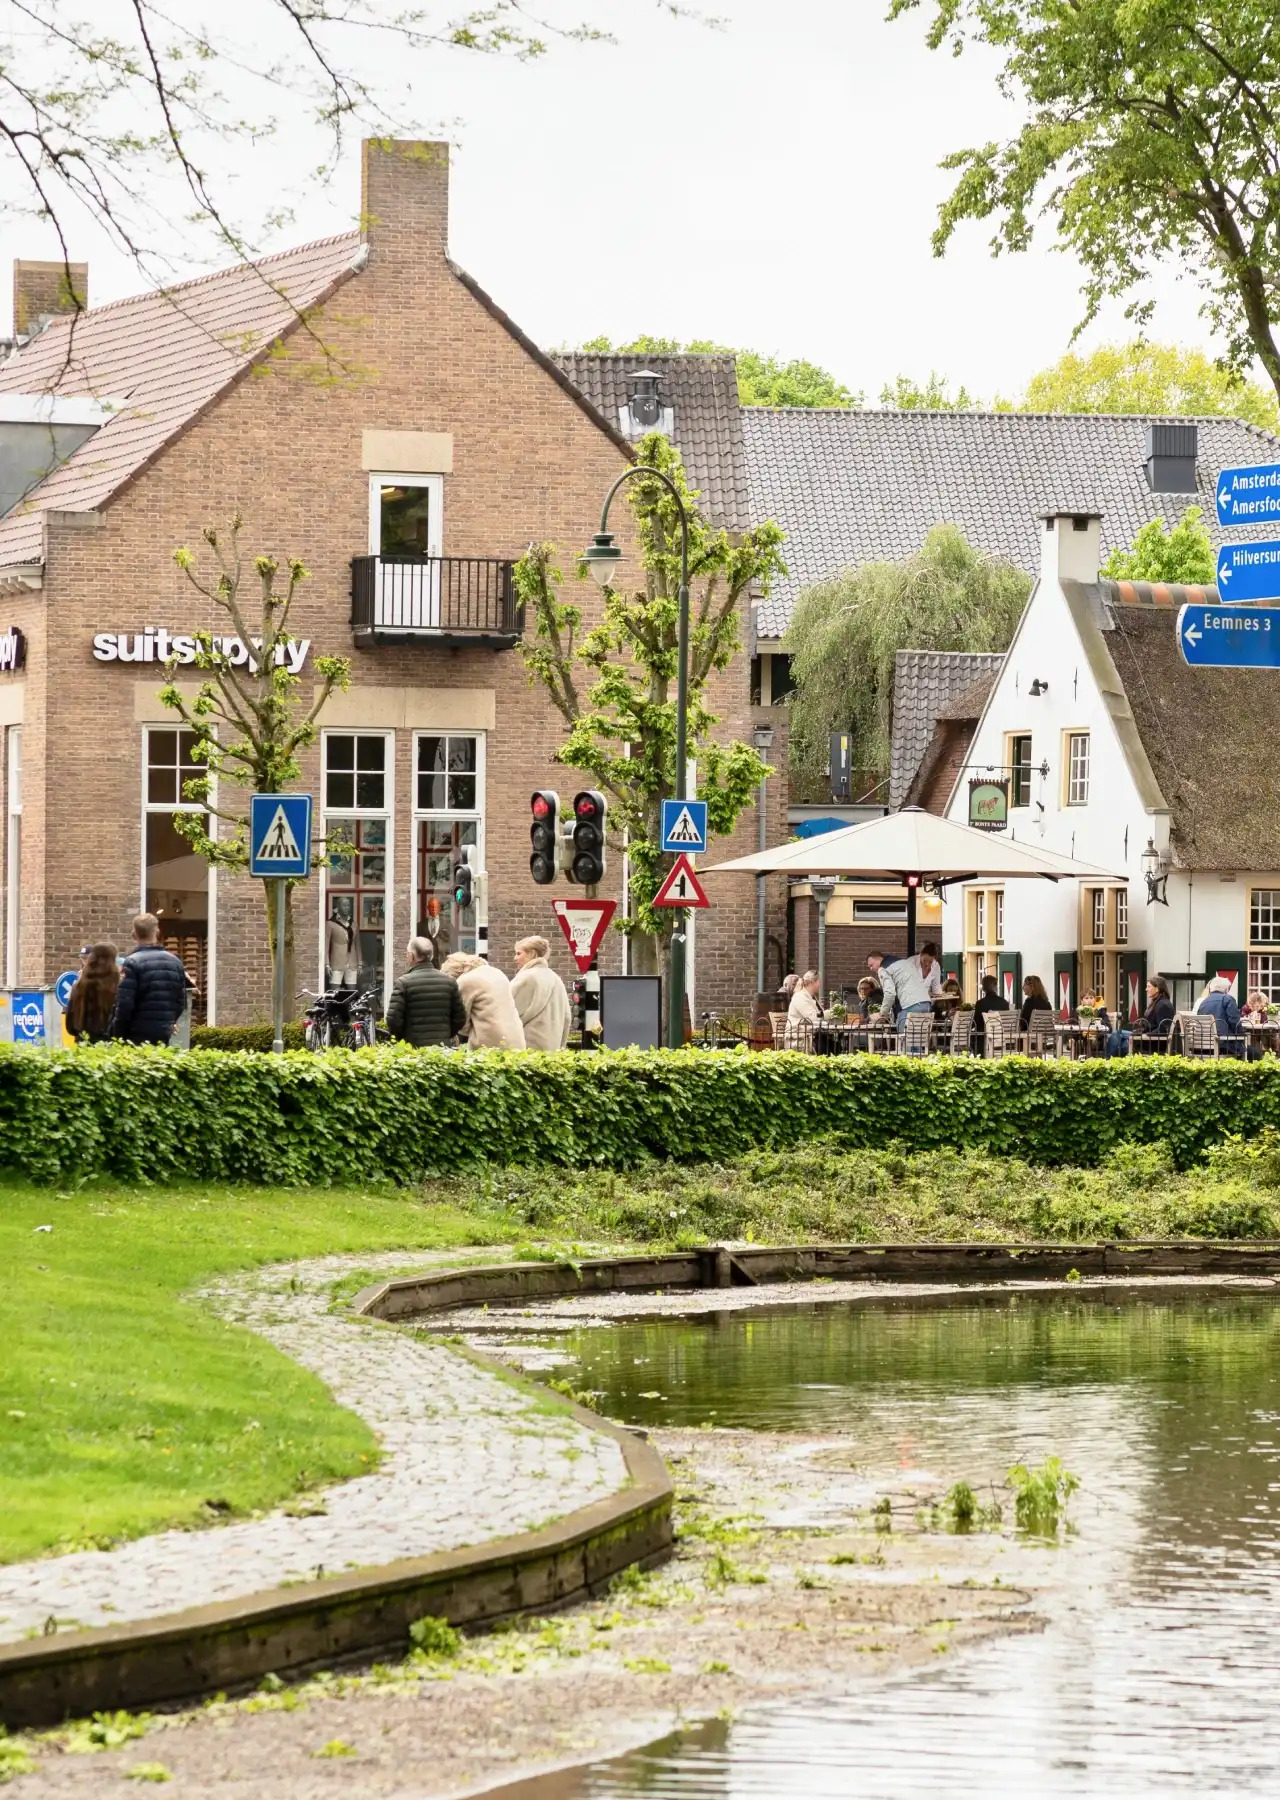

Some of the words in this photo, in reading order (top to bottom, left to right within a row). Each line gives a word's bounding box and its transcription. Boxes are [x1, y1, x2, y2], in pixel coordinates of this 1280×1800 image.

[1204, 613, 1260, 631] Eemnes
[1264, 618, 1271, 631] 3
[13, 1013, 43, 1026] renewi
